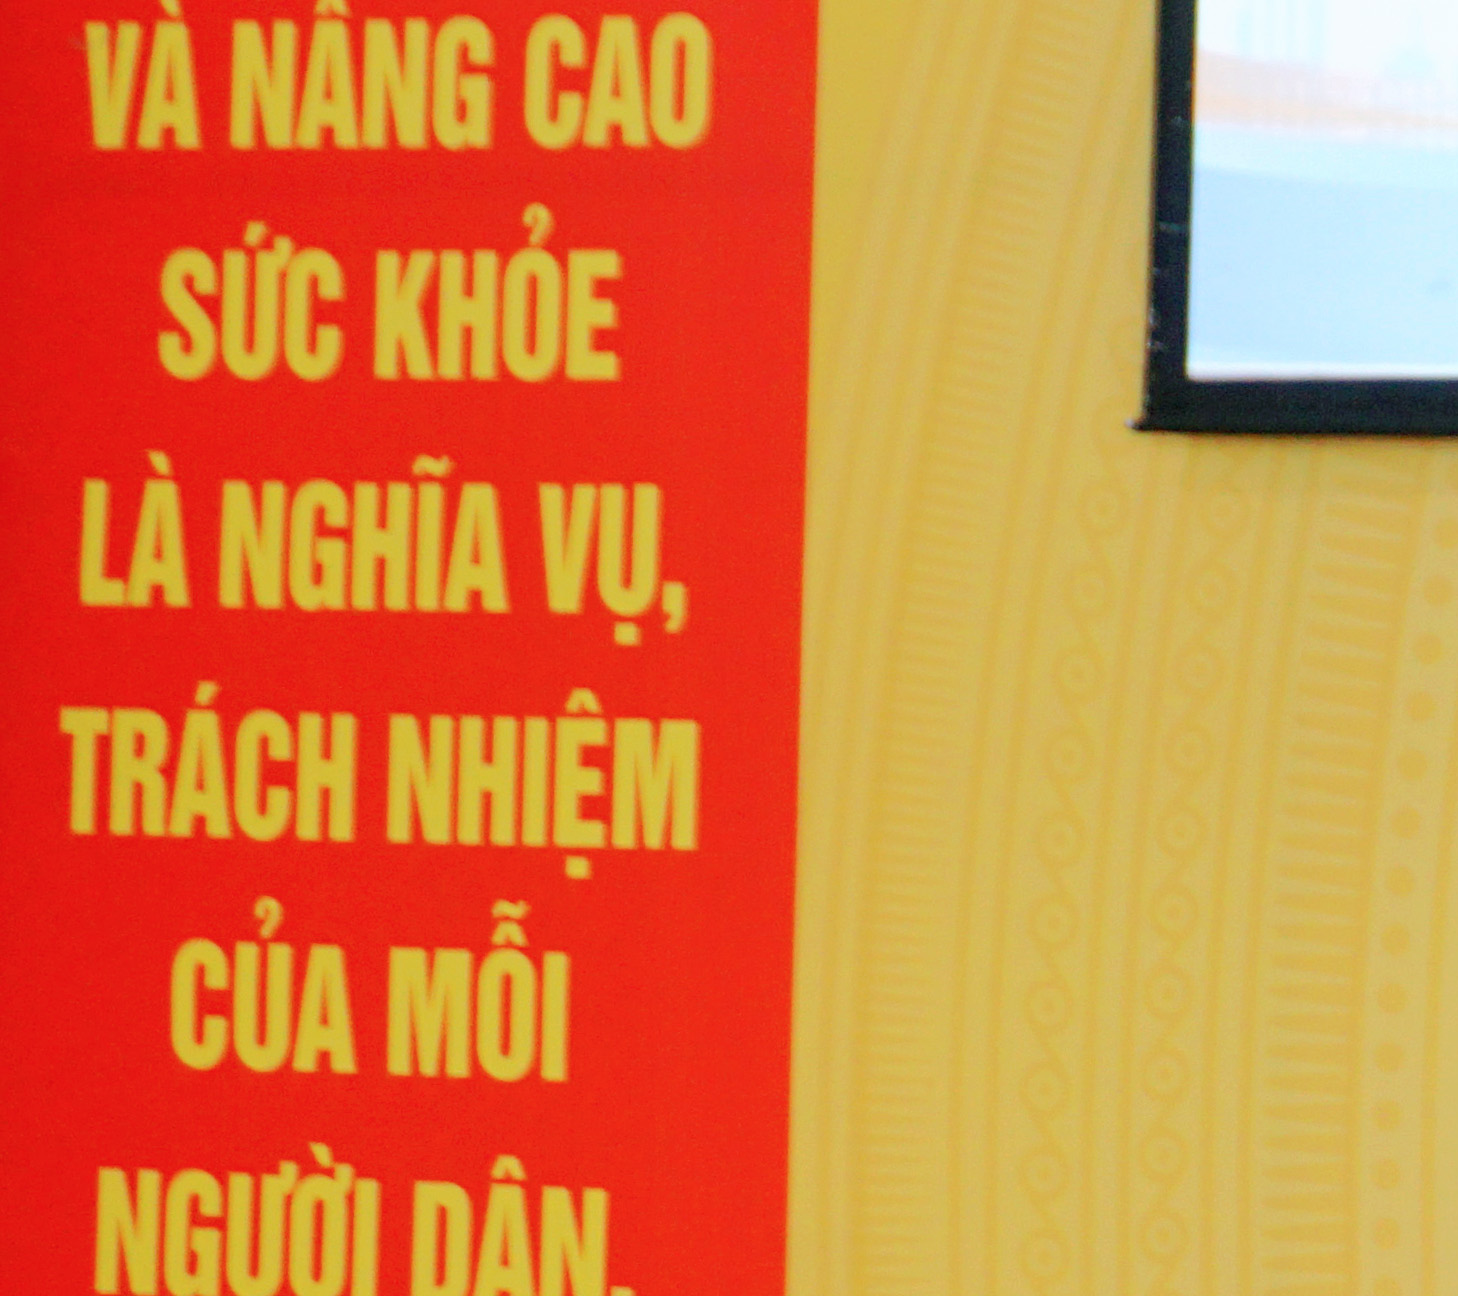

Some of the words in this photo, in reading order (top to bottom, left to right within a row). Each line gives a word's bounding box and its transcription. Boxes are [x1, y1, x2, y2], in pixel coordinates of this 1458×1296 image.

[524, 13, 712, 149] CAO
[159, 222, 343, 381] SỨC
[374, 204, 621, 382] KHỎE
[80, 452, 188, 606] LÀ
[220, 455, 509, 613] NGHĨA
[539, 483, 686, 645] VỤ,
[61, 682, 356, 841] TRÁCH
[387, 688, 699, 879] NHIỆM
[171, 897, 356, 1073] CỦA
[387, 900, 569, 1081] MỖI
